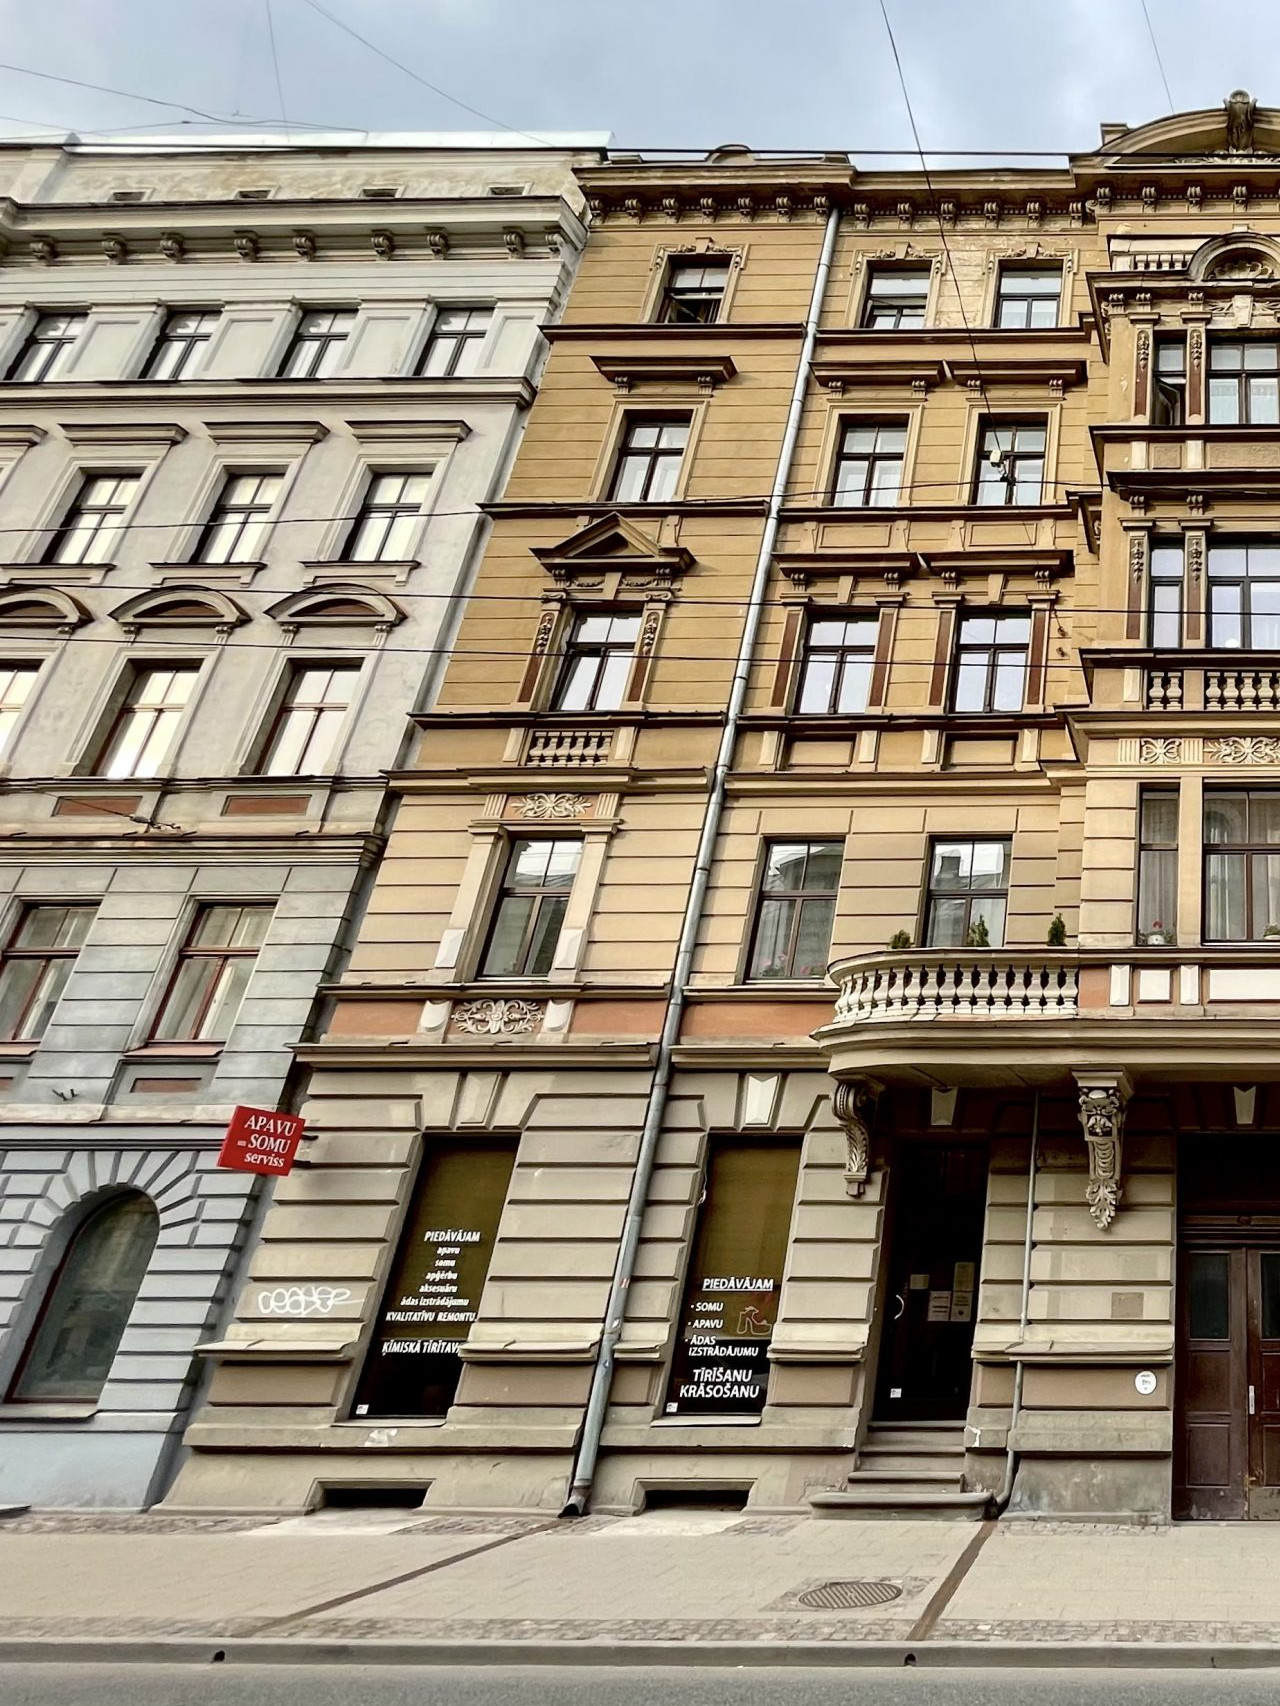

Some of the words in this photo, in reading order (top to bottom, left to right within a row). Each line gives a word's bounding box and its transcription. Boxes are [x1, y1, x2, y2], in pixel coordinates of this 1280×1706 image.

[244, 1115, 297, 1136] APAVU
[247, 1134, 291, 1154] SOMU
[244, 1152, 285, 1168] serviss
[424, 1229, 481, 1242] PIEDĀVĀJAM
[436, 1247, 461, 1256] apavu
[435, 1259, 456, 1267] somu
[702, 1277, 774, 1290] PIEDĀVĀJAM
[695, 1302, 724, 1312] SOMU
[385, 1310, 436, 1322] KVALITATĪVU
[692, 1319, 724, 1329] APAVU
[690, 1334, 717, 1345] ĀDAS
[381, 1340, 422, 1356] ĶĪMISKĀ
[688, 1345, 760, 1357] IZSTRĀDĀJUMU
[692, 1366, 753, 1382] TĪRĪŠANU
[679, 1382, 760, 1398] KRĀSOŠANU
